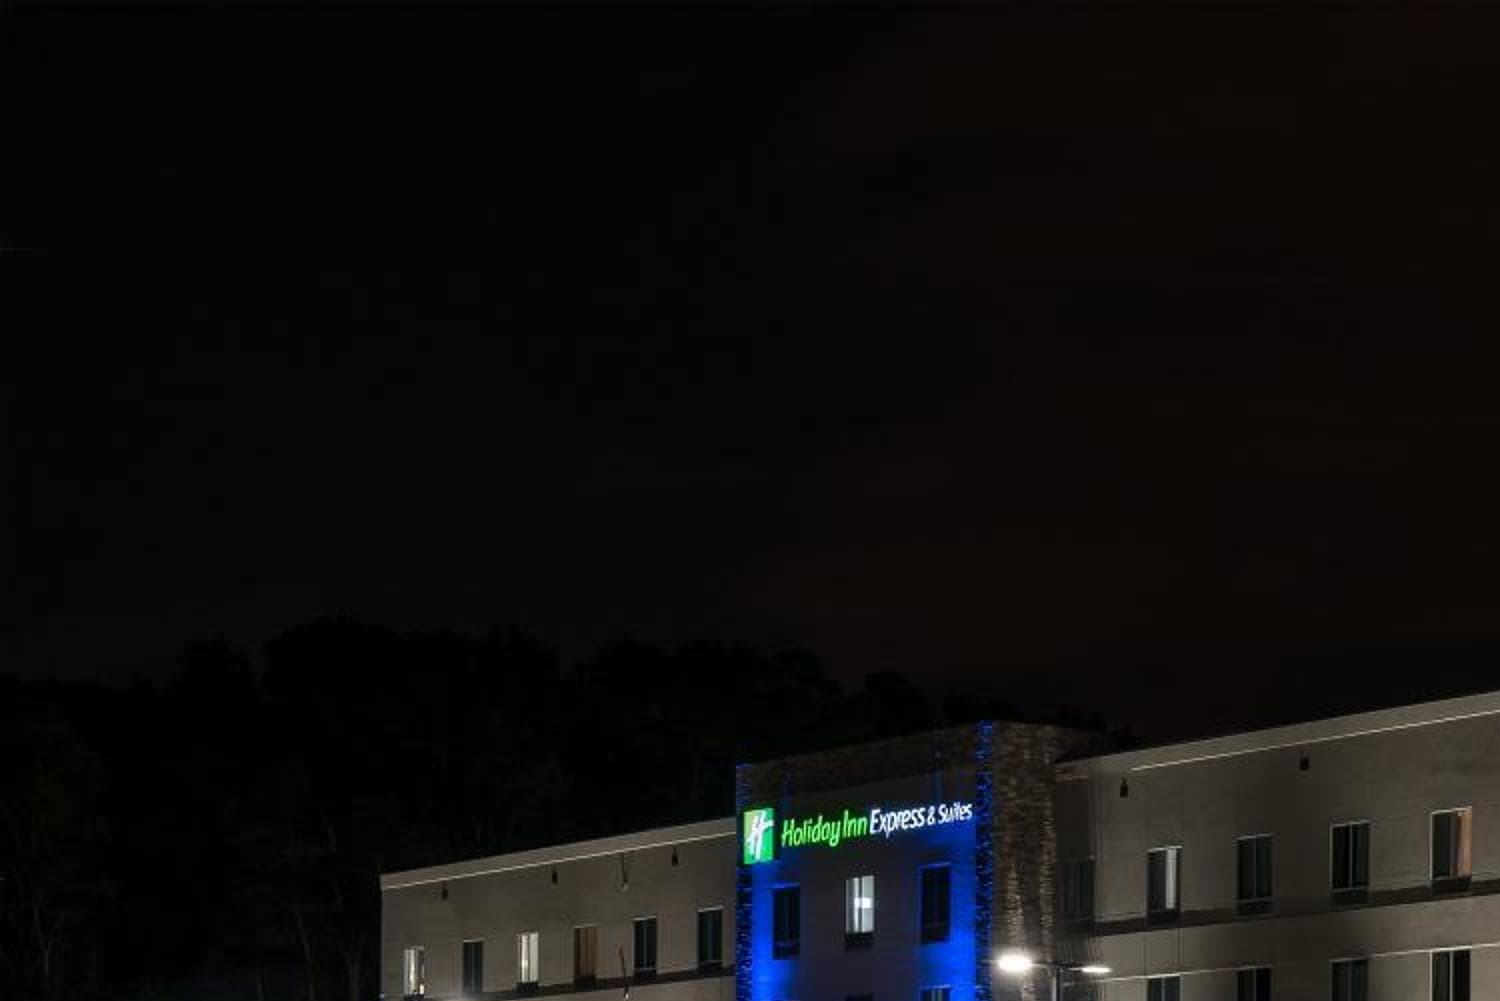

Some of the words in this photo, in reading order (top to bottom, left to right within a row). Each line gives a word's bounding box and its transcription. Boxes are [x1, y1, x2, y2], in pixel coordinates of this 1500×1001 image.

[781, 815, 841, 847] Holiday
[842, 809, 867, 838] Inn
[870, 808, 925, 839] Express
[927, 805, 936, 826] &
[938, 802, 973, 824] Suites
